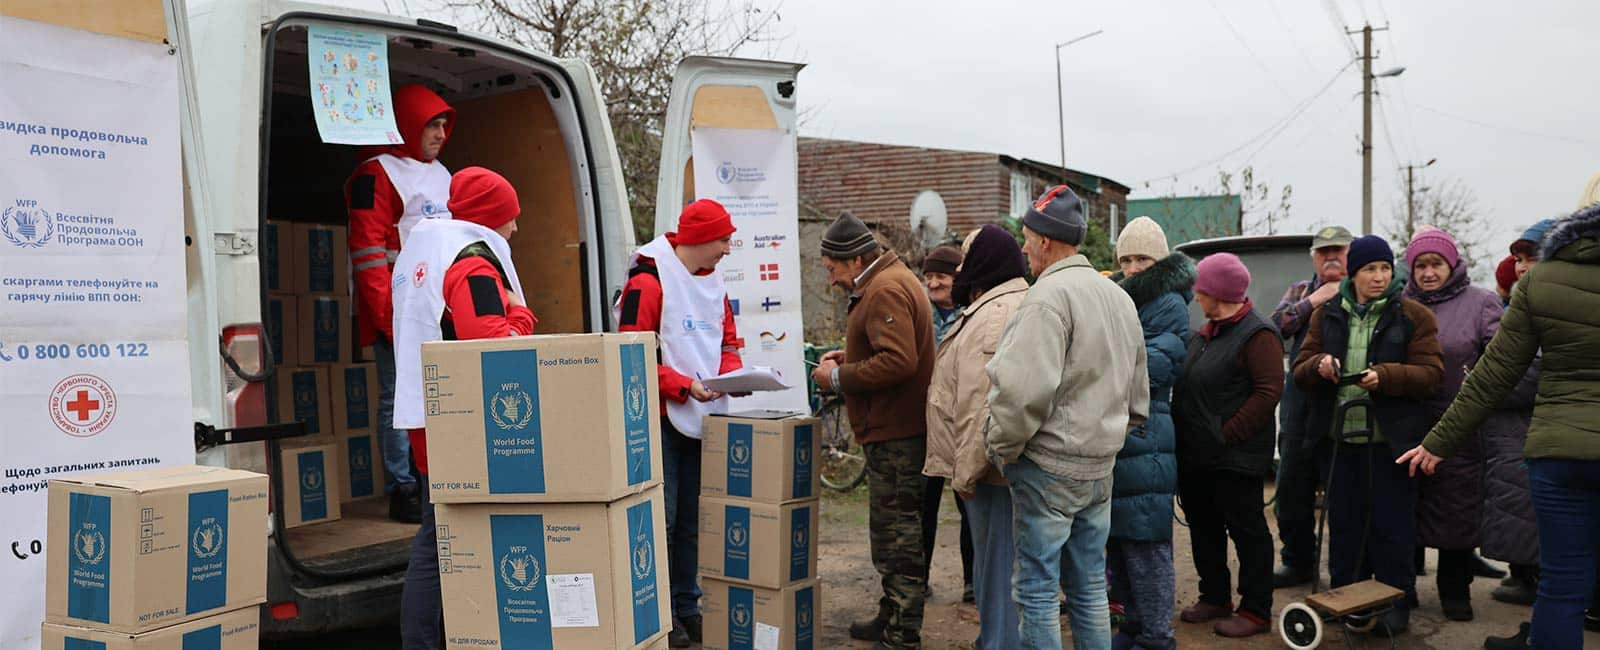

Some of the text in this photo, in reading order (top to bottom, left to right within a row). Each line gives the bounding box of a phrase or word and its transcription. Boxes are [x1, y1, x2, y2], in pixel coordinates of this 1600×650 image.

[51, 127, 148, 146] продовольча
[30, 143, 106, 160] допомога
[16, 199, 38, 208] WFP
[56, 212, 114, 225] Всесвітня
[57, 223, 137, 236] Продовольча
[57, 234, 144, 247] Програма ООН
[3, 277, 159, 290] скаргами телефонуйте на
[8, 292, 142, 303] гарячу лінію ВПП ООН:
[17, 343, 149, 360] 0 800 600 122
[559, 358, 583, 366] Ration
[584, 357, 599, 365] Box
[501, 383, 519, 391] WFP
[493, 438, 535, 447] World Food
[493, 448, 535, 457] Programme
[5, 457, 161, 479] Щодо загальних запитань
[0, 479, 48, 495] ефонуй
[510, 546, 527, 554] WFP
[192, 564, 208, 573] World
[74, 569, 105, 580] World Food
[192, 570, 222, 582] Programme
[73, 578, 105, 588] Programme
[165, 607, 179, 615] SALE
